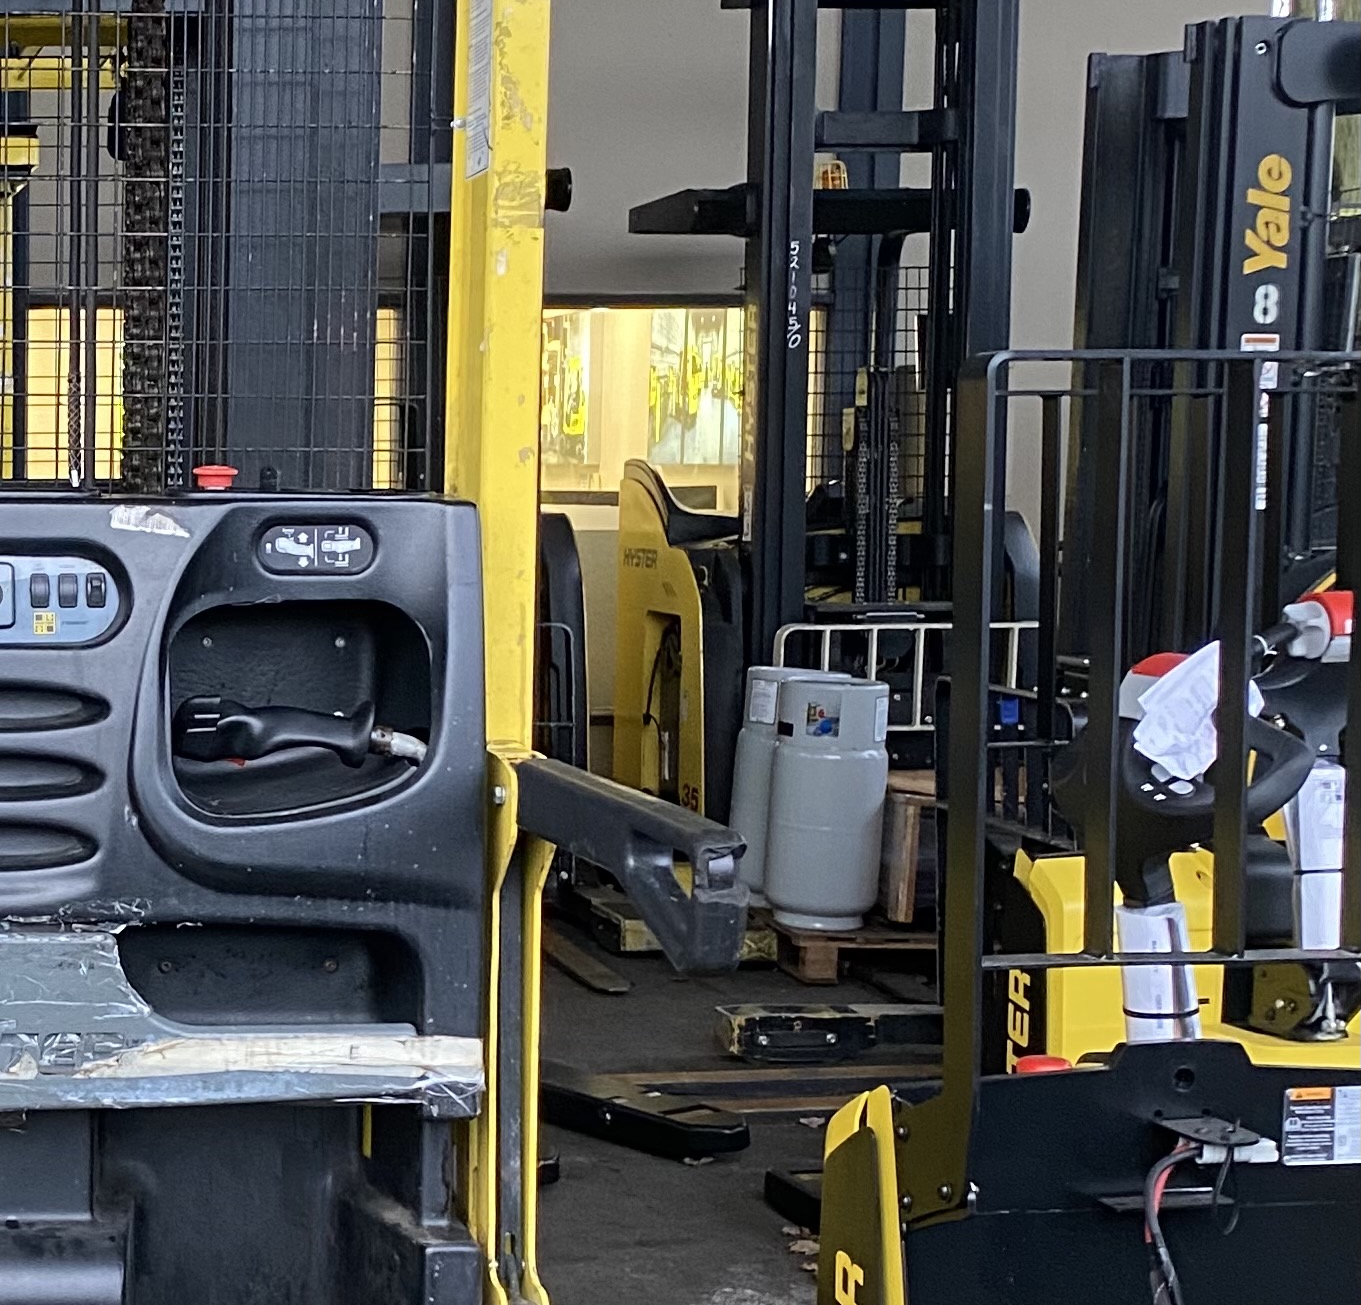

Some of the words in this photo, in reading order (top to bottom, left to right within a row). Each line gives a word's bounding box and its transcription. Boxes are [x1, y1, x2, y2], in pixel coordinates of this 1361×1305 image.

[1243, 153, 1292, 275] Yale
[1253, 284, 1279, 324] 8
[623, 548, 657, 569] HYSTER
